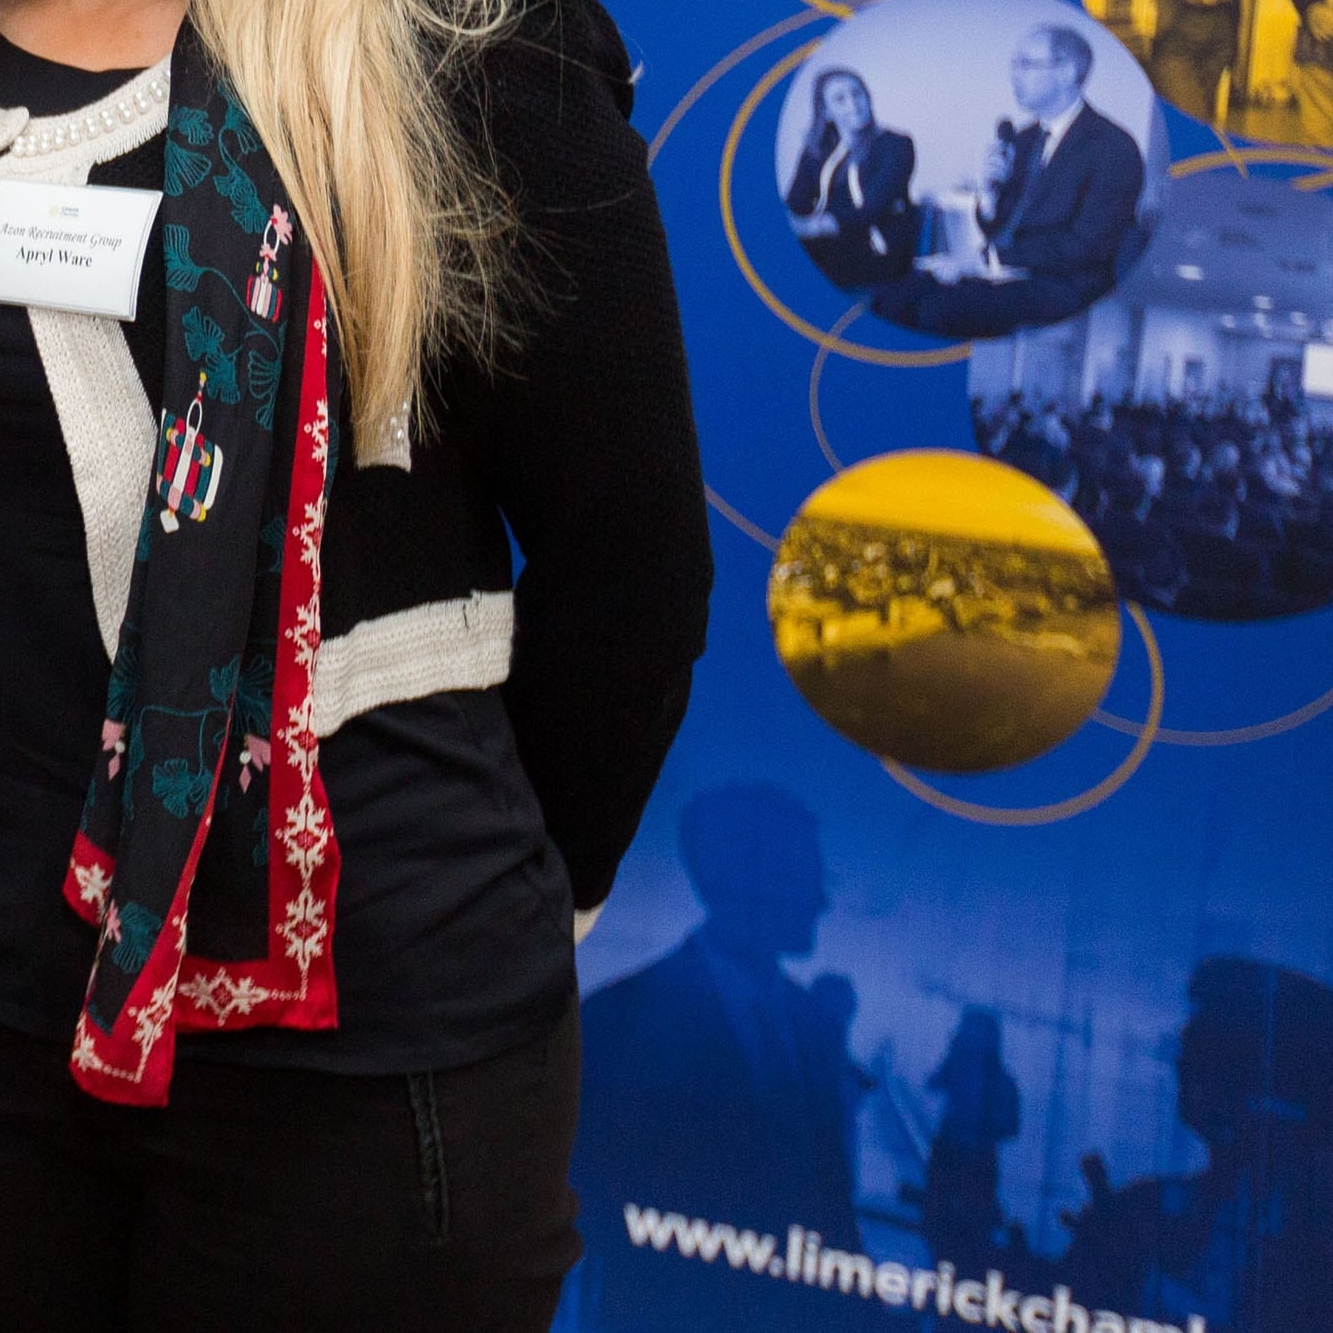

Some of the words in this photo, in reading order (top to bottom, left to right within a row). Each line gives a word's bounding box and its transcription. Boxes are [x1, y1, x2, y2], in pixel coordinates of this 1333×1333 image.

[28, 226, 87, 243] Recruitment
[90, 233, 122, 251] Group
[15, 245, 54, 266] Apryl
[57, 248, 93, 267] Ware
